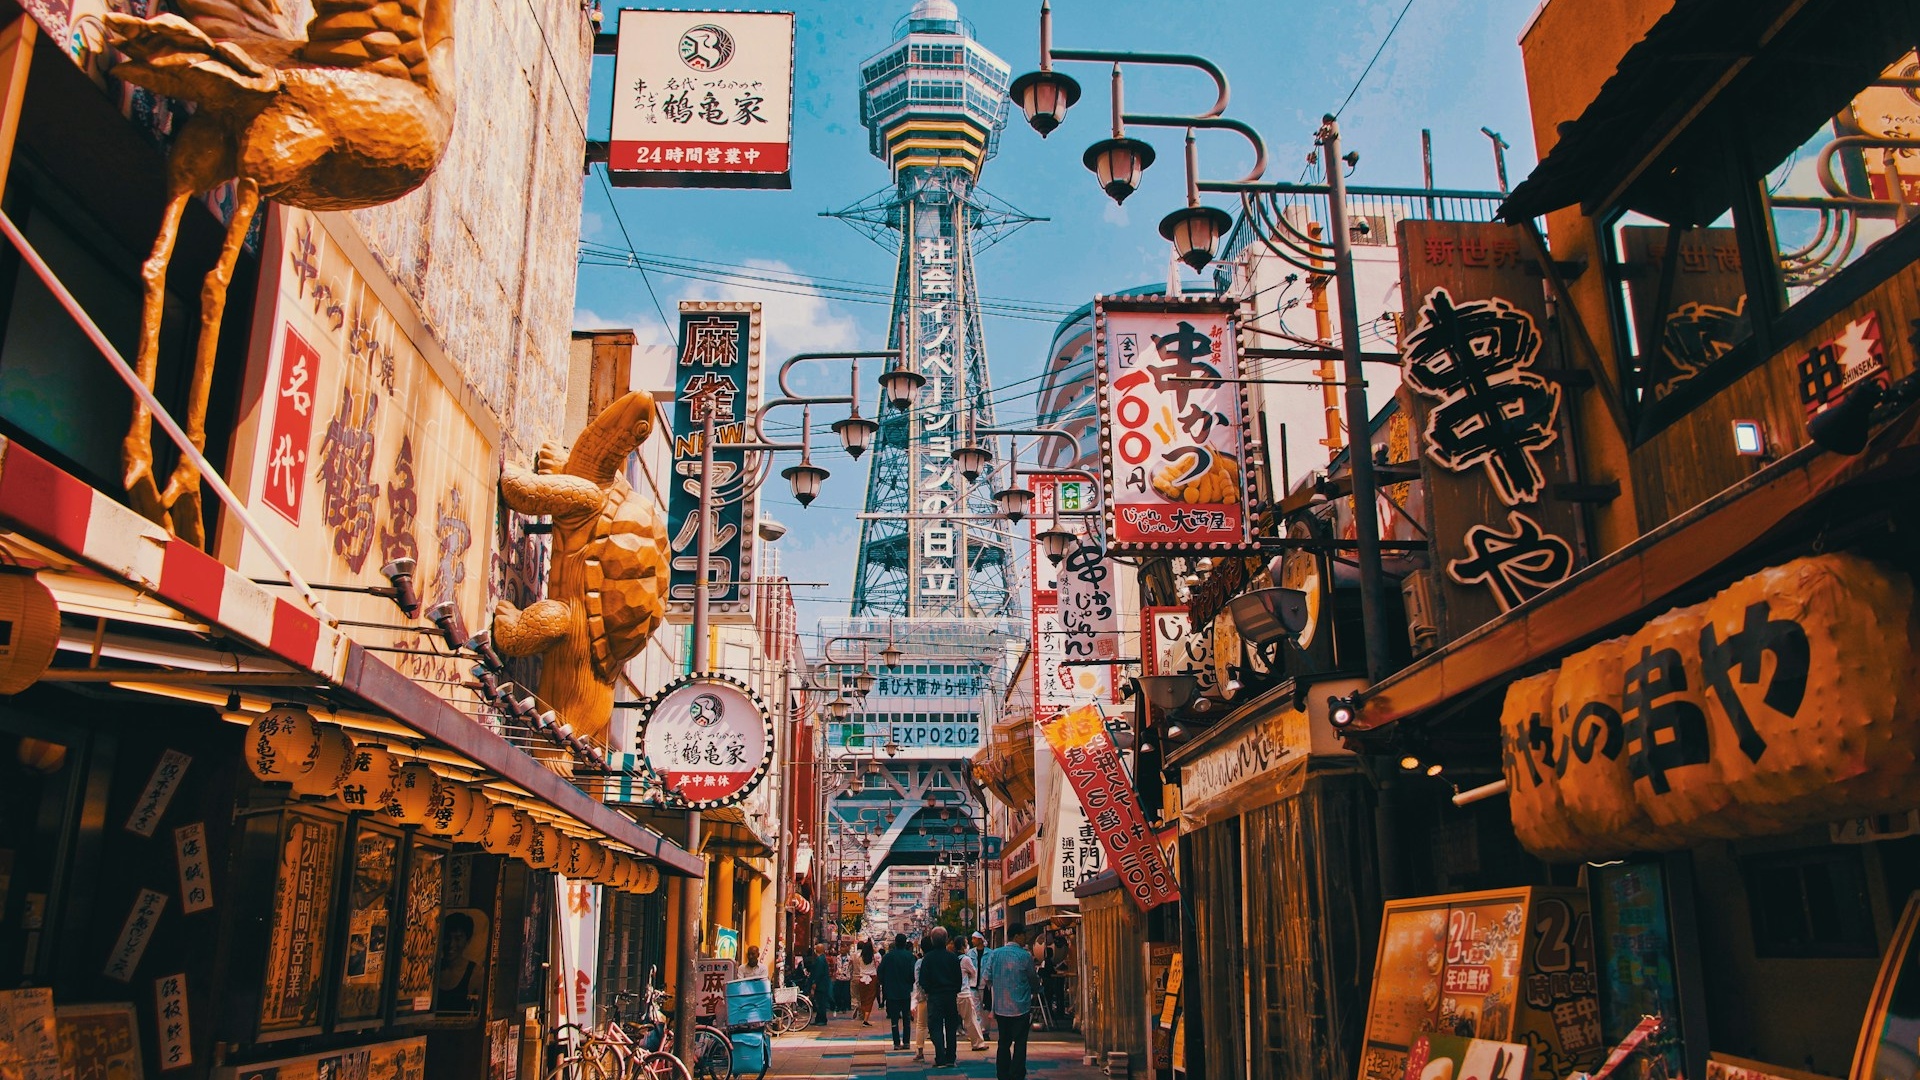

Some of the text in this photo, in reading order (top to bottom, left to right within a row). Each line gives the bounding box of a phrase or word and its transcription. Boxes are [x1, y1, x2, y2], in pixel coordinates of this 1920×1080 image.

[664, 77, 698, 91] 名代
[662, 90, 769, 126] 鶴亀家
[636, 146, 761, 165] 24時間営業中
[1425, 236, 1522, 269] 新世界
[1119, 336, 1136, 366] 全て
[678, 316, 740, 424] 麻雀
[919, 238, 957, 597] 社会イノベーションの日立
[1147, 320, 1230, 487] 串かつ
[262, 355, 312, 510] 名代
[1170, 507, 1232, 534] 大西屋
[1065, 540, 1113, 621] 串かつ
[879, 678, 980, 696] 再び大阪から世界
[281, 715, 297, 735] 名代
[892, 727, 980, 744] EXPO202
[257, 714, 281, 776] 鶴亀家
[682, 740, 748, 766] 鶴亀家
[680, 774, 731, 788] 年中無休
[1061, 836, 1076, 893] 通天閣店
[698, 963, 730, 972] 全自動卓
[1446, 968, 1490, 991] 年中無休
